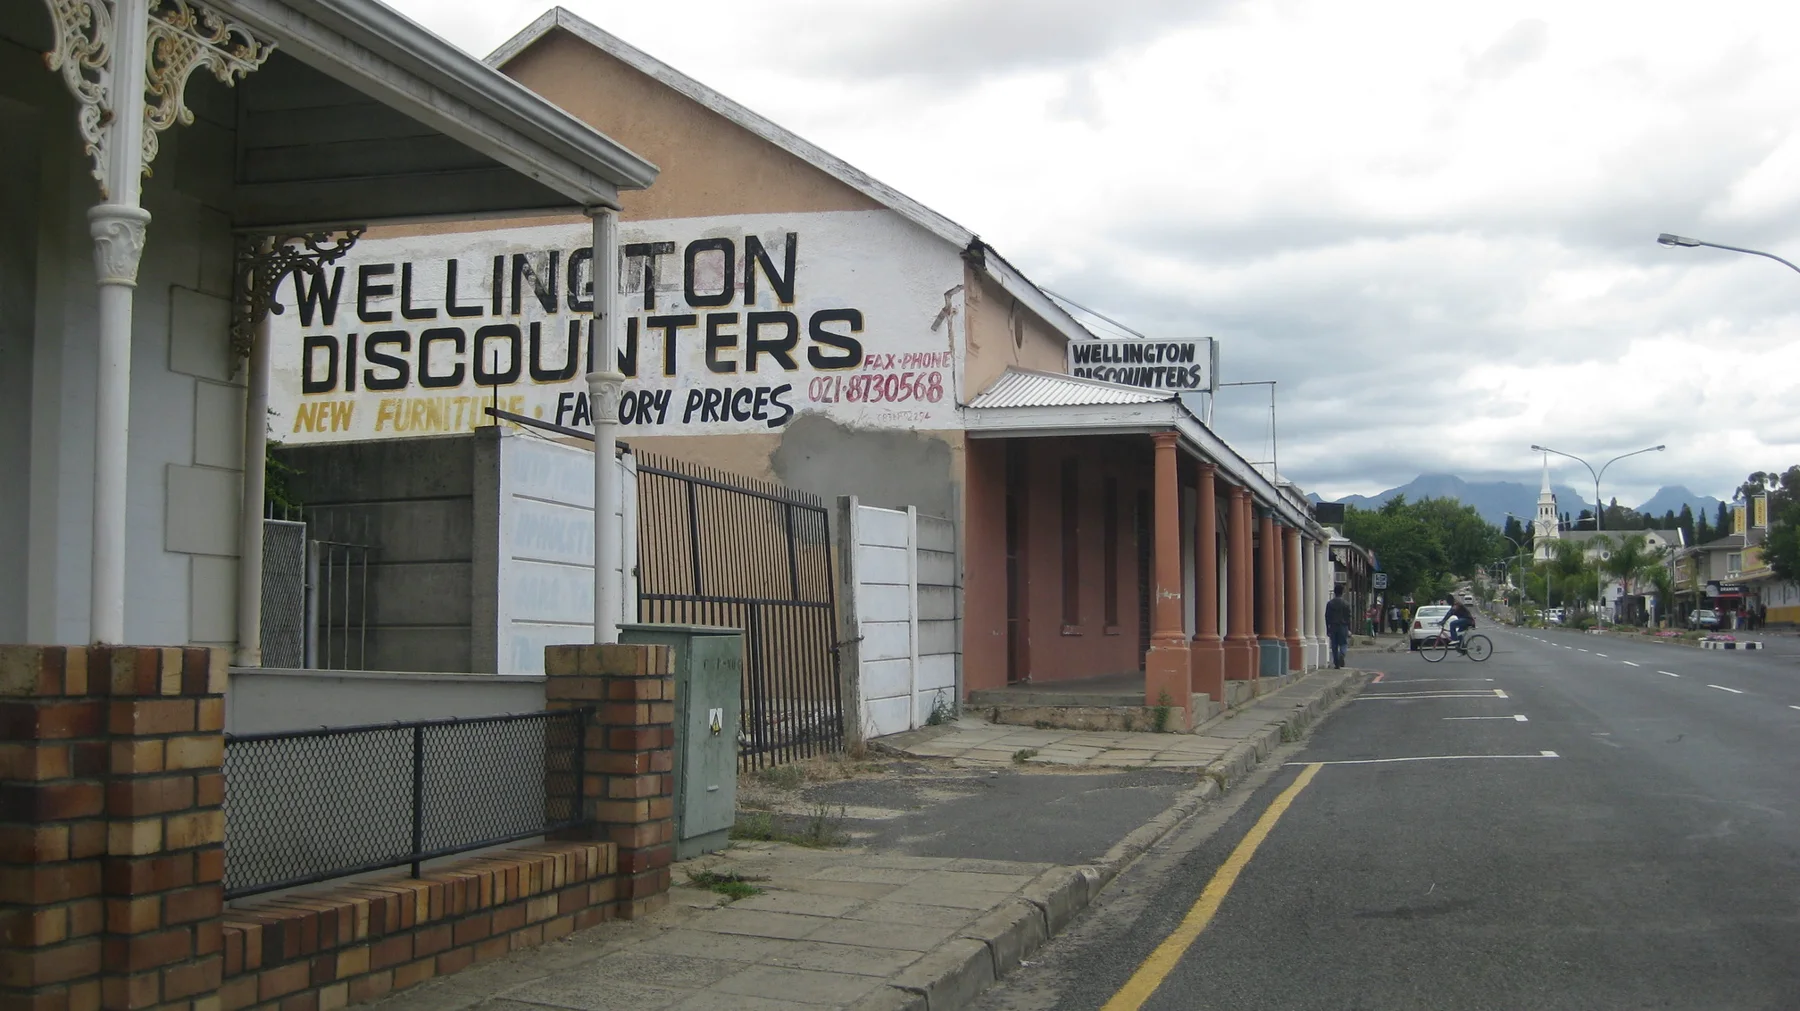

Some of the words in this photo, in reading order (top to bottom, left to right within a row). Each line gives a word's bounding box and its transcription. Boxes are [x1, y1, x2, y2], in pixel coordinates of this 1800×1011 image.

[294, 232, 797, 327] WELLINGTON
[302, 308, 863, 394] DISCOUNTERS
[1073, 343, 1195, 363] WELLINGTON
[293, 401, 354, 433] NEW
[555, 389, 672, 427] FAORY
[683, 384, 794, 428] PRICES
